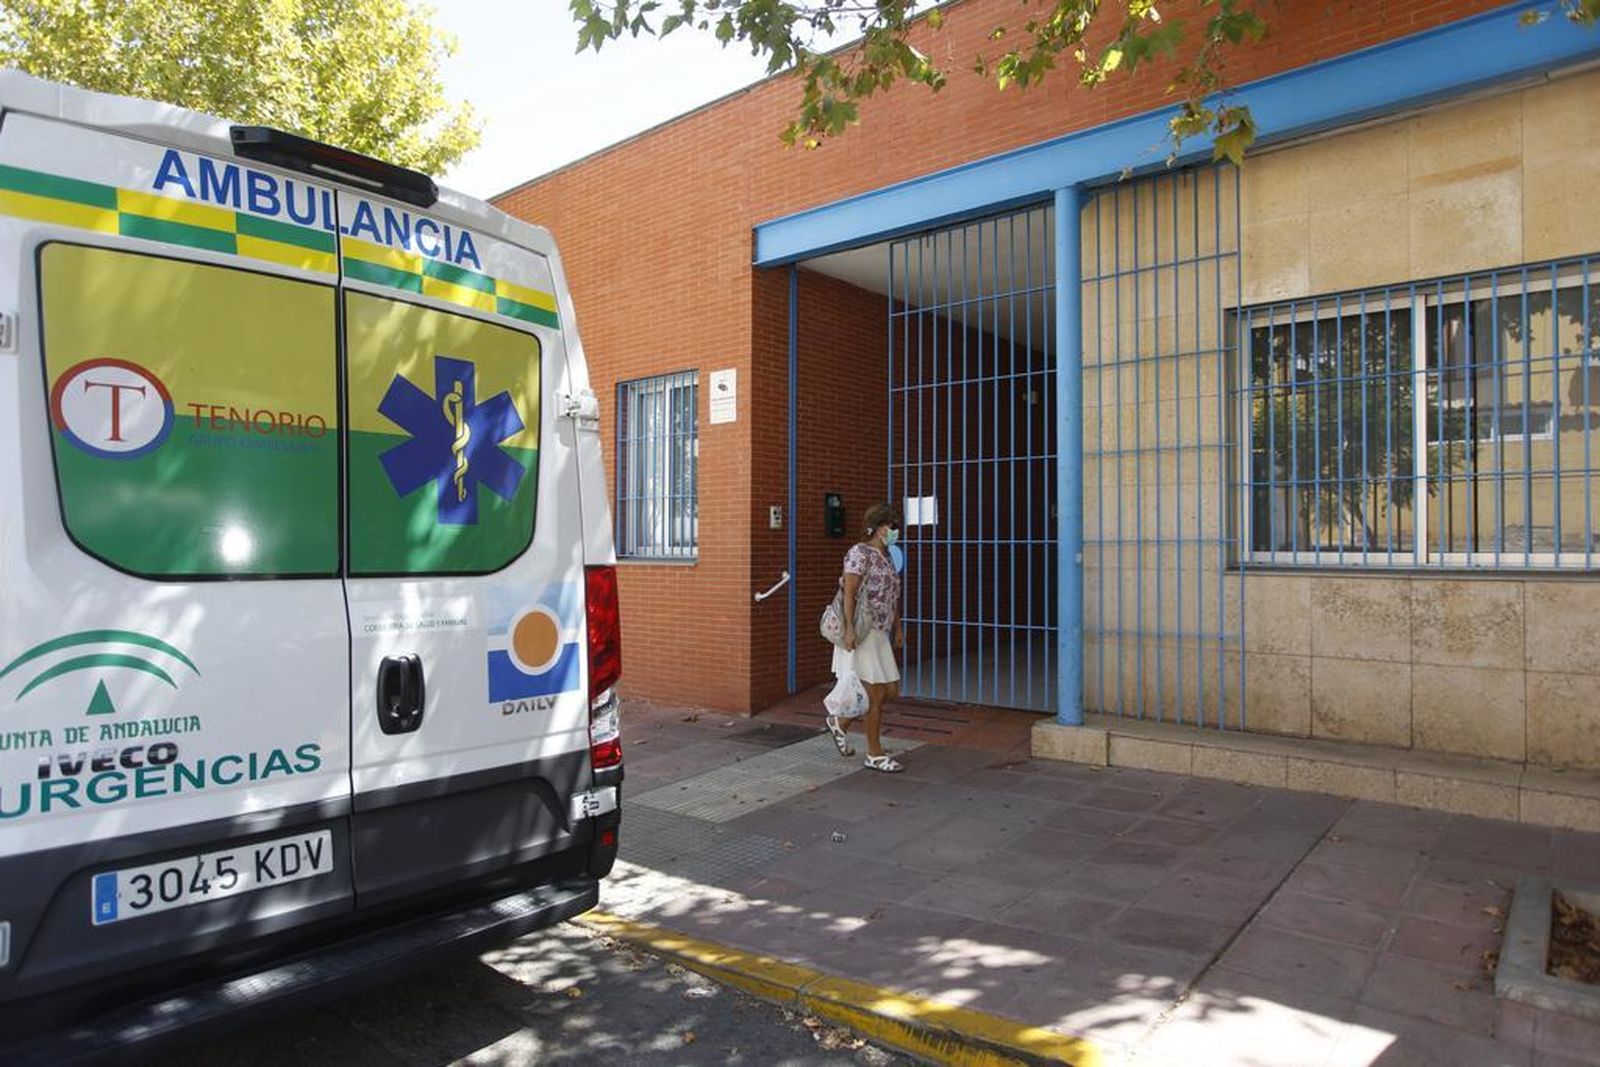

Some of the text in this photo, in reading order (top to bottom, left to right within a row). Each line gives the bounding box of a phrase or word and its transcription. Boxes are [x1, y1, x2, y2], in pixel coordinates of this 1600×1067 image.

[152, 149, 482, 270] AMBULANCIA
[85, 380, 146, 442] T
[187, 402, 327, 438] TENORIO
[0, 715, 201, 751] UNTA DE ANDALUCIA
[37, 741, 179, 780] IVECO
[0, 743, 322, 819] URGENCIAS
[129, 837, 324, 909] 3045 KDV
